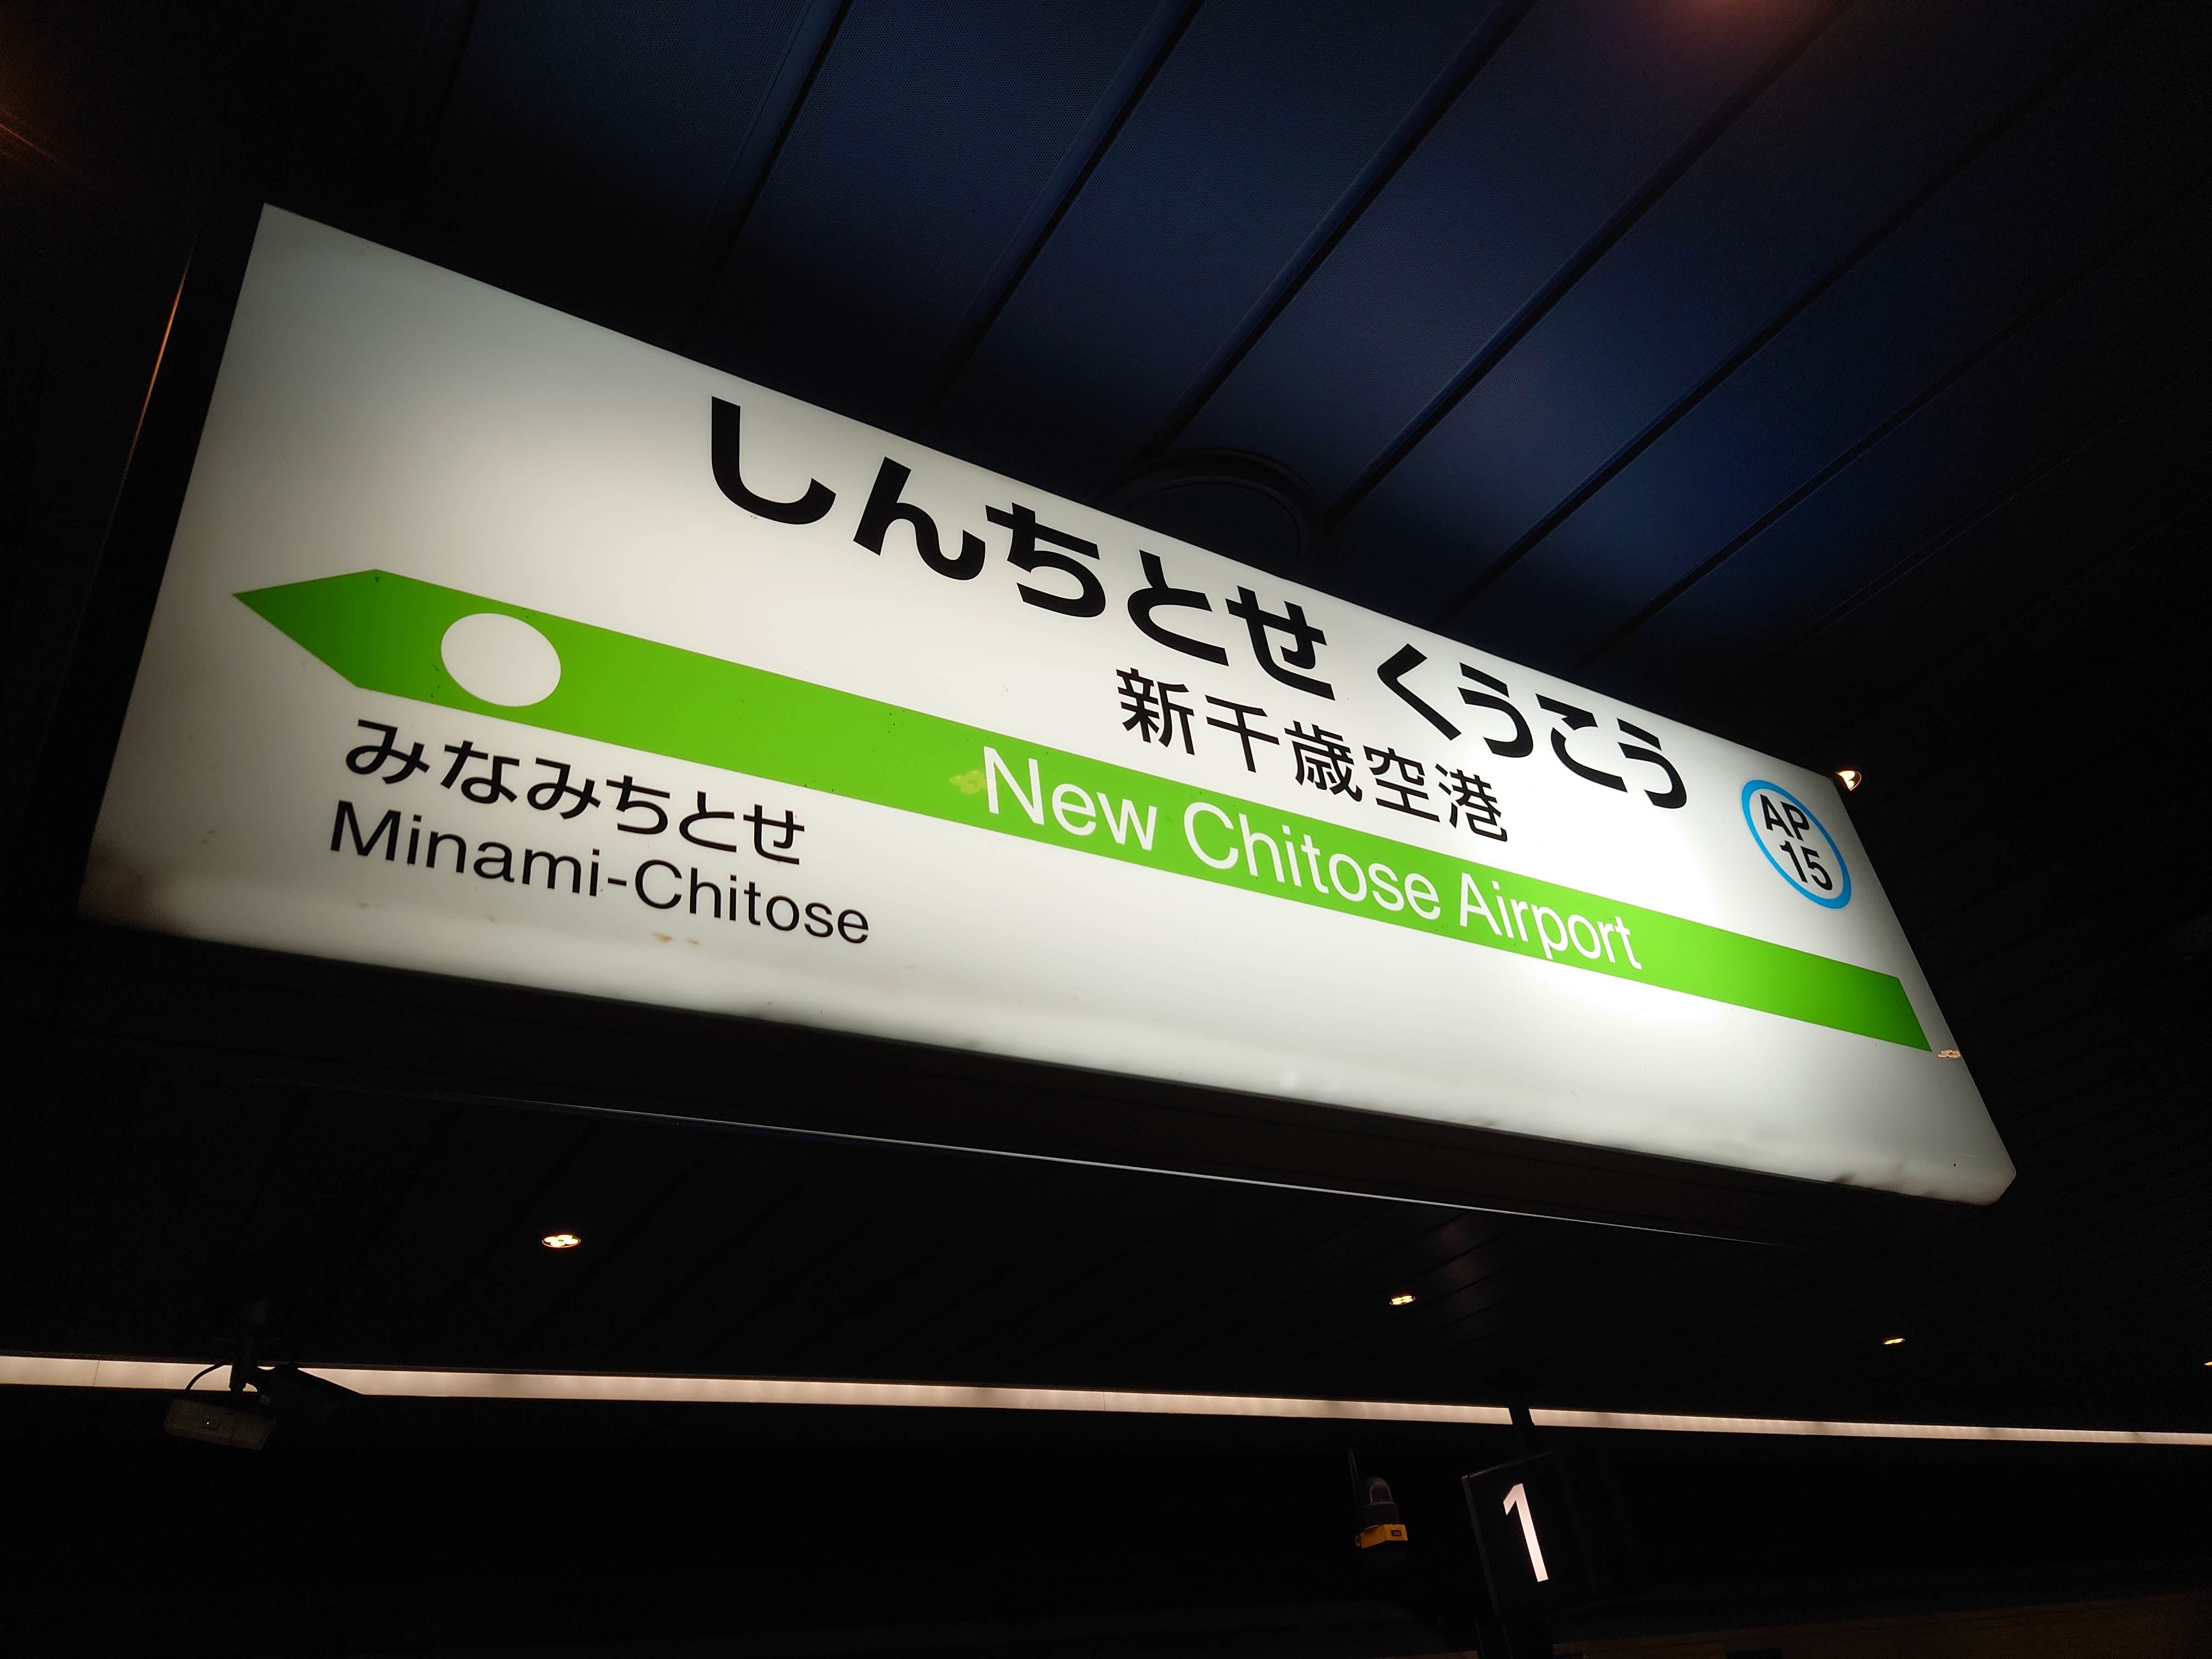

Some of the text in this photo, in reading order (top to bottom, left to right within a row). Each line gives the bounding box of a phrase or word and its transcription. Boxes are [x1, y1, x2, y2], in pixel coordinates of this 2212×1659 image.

[711, 396, 1686, 809] しんちとせ くうこう
[345, 719, 805, 865] みなみちとせ
[1115, 666, 1508, 843] 新千歳空港
[1759, 794, 1810, 842] AP
[330, 800, 870, 944] Minami-Chitose
[983, 747, 1643, 970] New Chitose Airport
[1779, 840, 1833, 891] 15
[1502, 1482, 1549, 1583] 1
